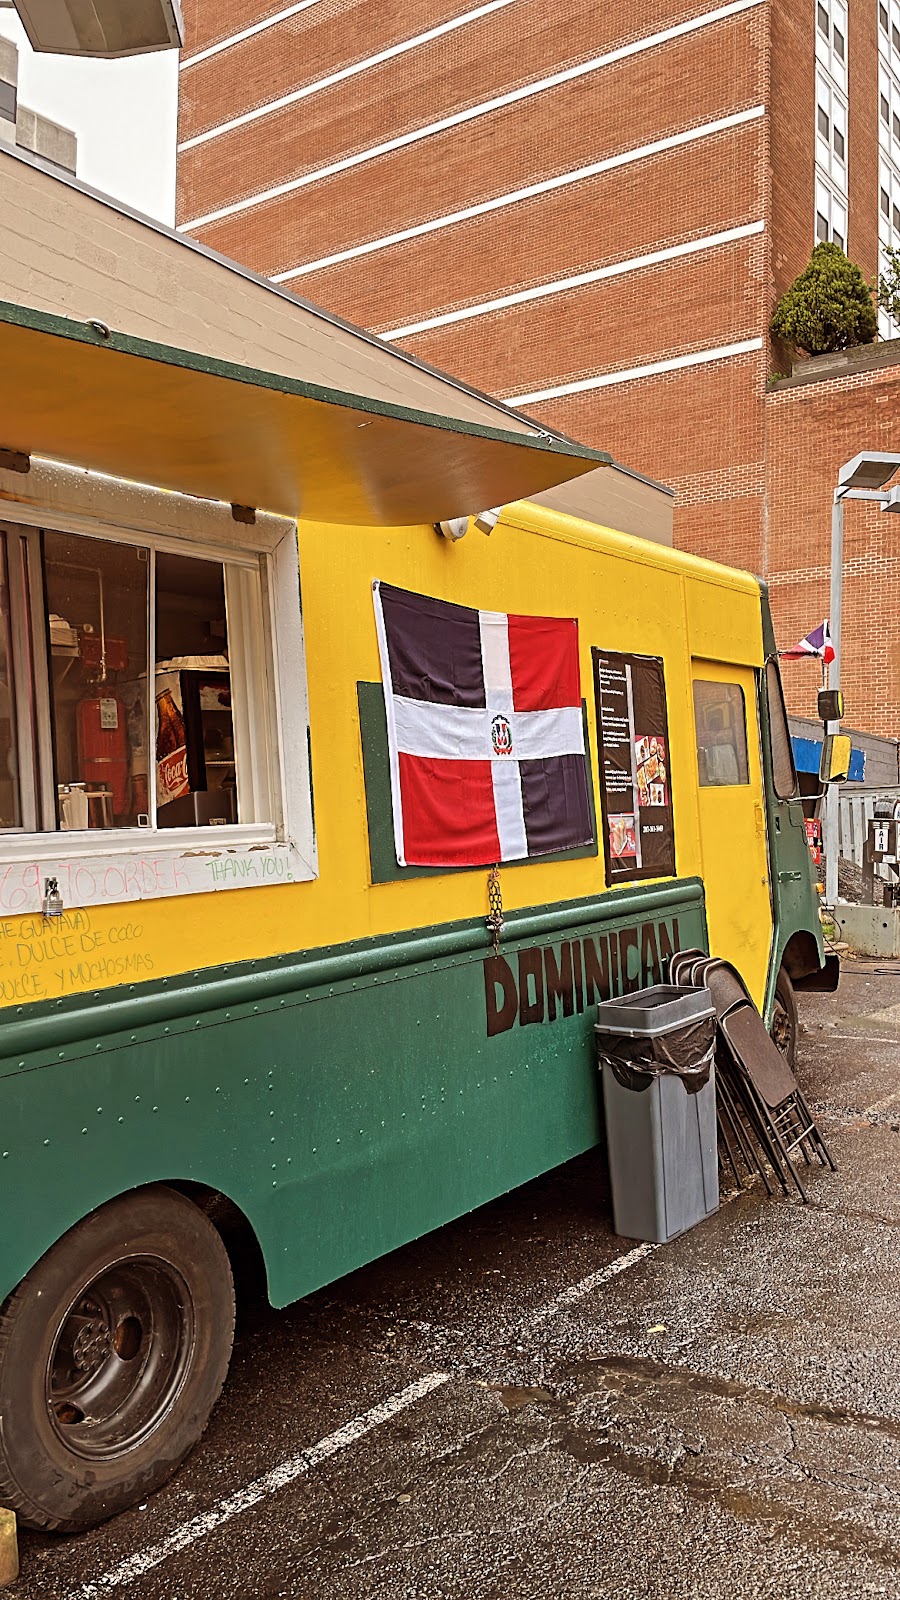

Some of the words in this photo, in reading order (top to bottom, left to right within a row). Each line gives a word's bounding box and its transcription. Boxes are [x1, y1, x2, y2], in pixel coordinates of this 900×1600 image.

[58, 863, 96, 901] TO
[103, 857, 190, 896] ORDER
[205, 857, 258, 881] THANK
[260, 856, 293, 880] YOU!
[17, 936, 75, 967] DULCE
[80, 932, 105, 952] DE
[54, 969, 65, 990] Y
[483, 918, 681, 1038] DOMINICAN
